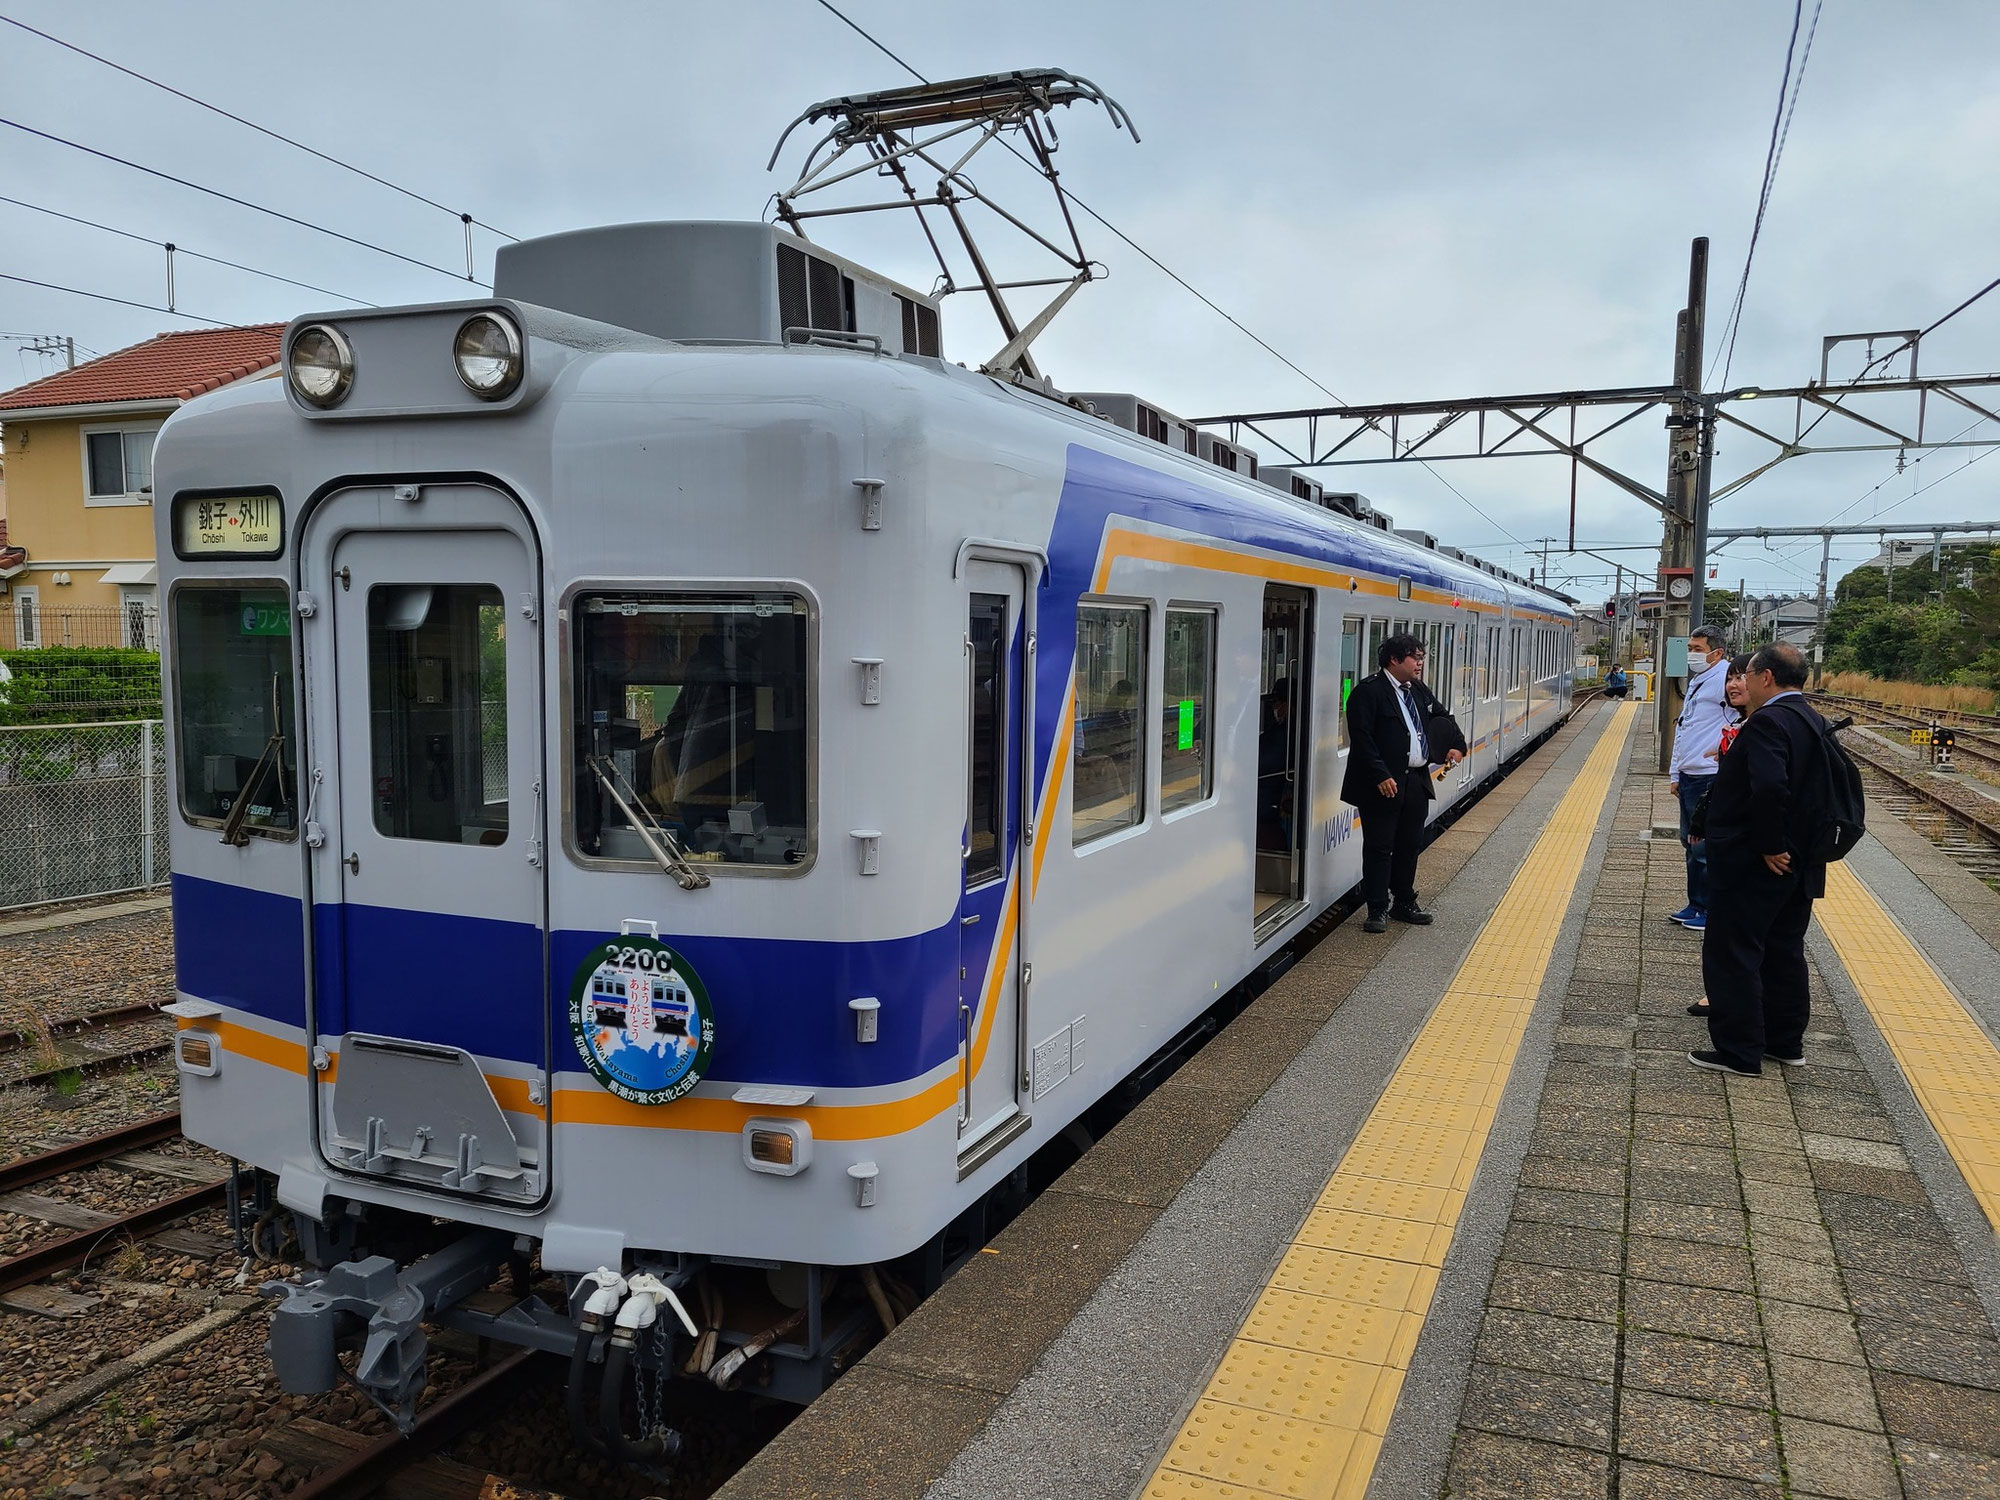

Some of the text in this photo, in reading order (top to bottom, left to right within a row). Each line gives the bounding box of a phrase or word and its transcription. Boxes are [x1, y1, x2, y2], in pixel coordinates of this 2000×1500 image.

[199, 498, 270, 530] 銚子 外川
[241, 531, 269, 542] Tokawa
[605, 944, 673, 973] 2200
[629, 978, 640, 1040] ありがとう
[641, 980, 651, 1029] ようこそ
